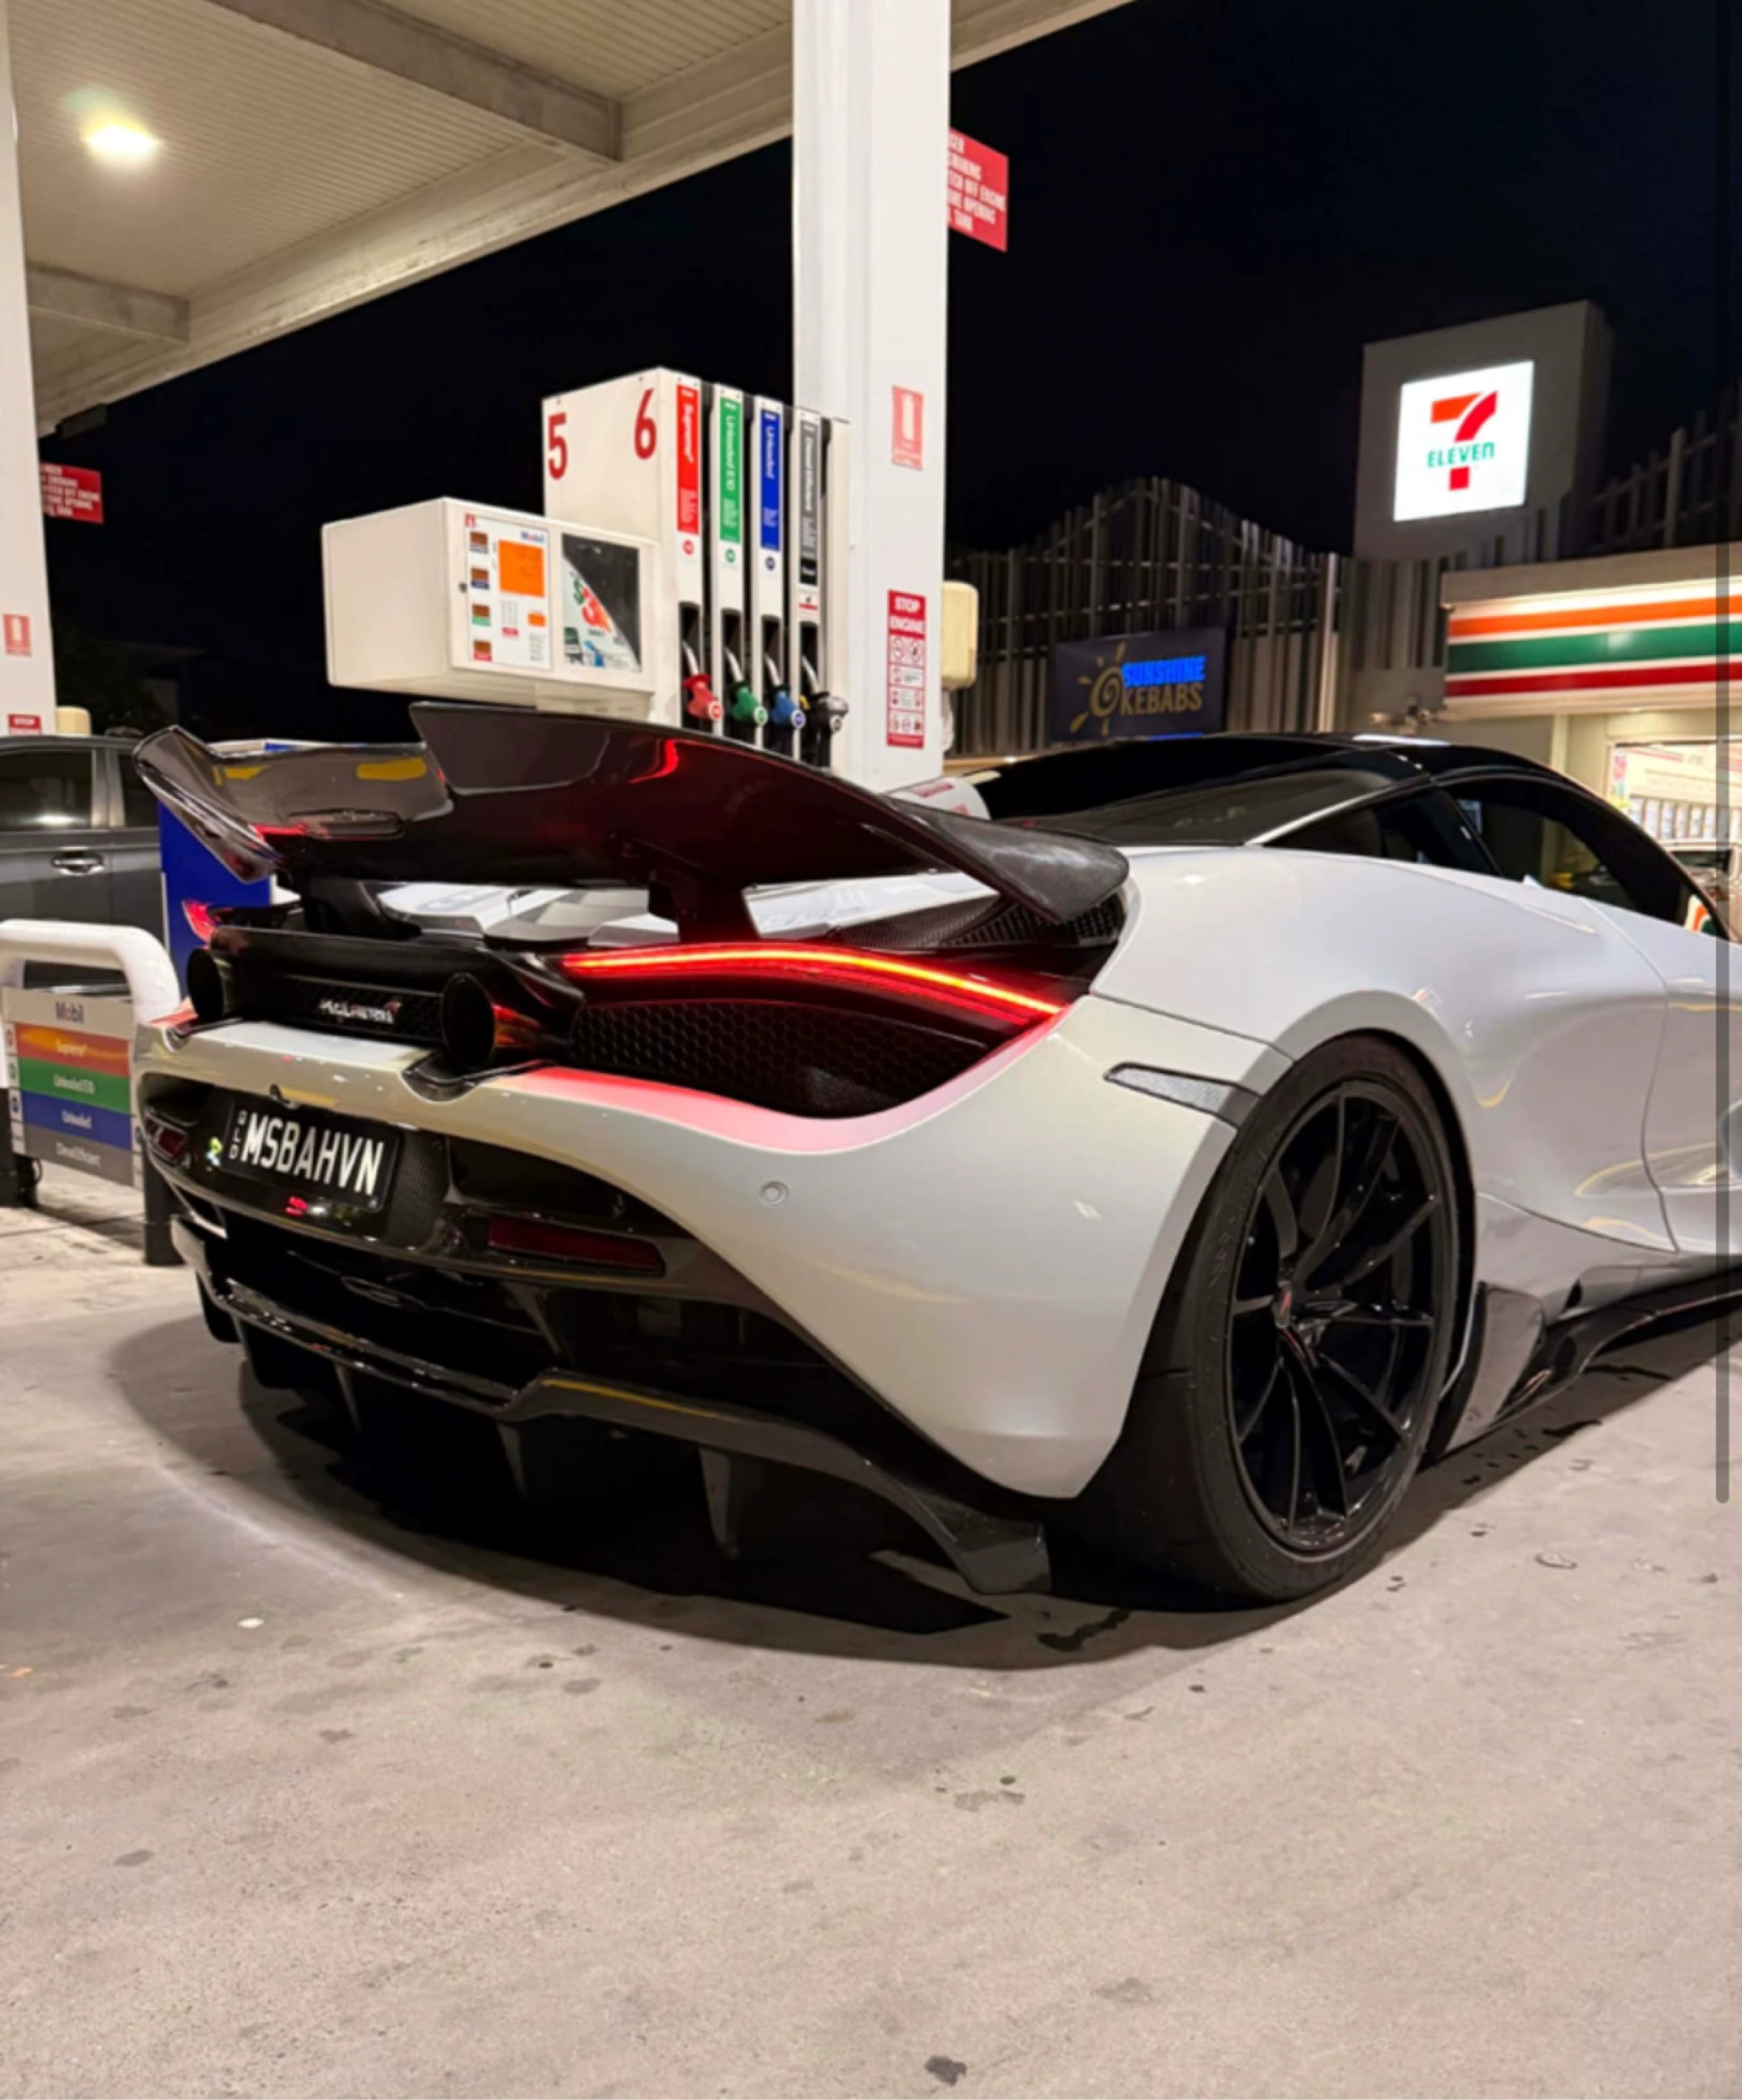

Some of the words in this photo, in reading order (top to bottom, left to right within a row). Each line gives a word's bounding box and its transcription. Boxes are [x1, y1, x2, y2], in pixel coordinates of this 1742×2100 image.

[548, 412, 567, 480] 5
[634, 388, 657, 460] 6
[1430, 389, 1498, 491] 7
[1120, 682, 1203, 715] KEBABS
[240, 1112, 384, 1195] MSBAHVN
